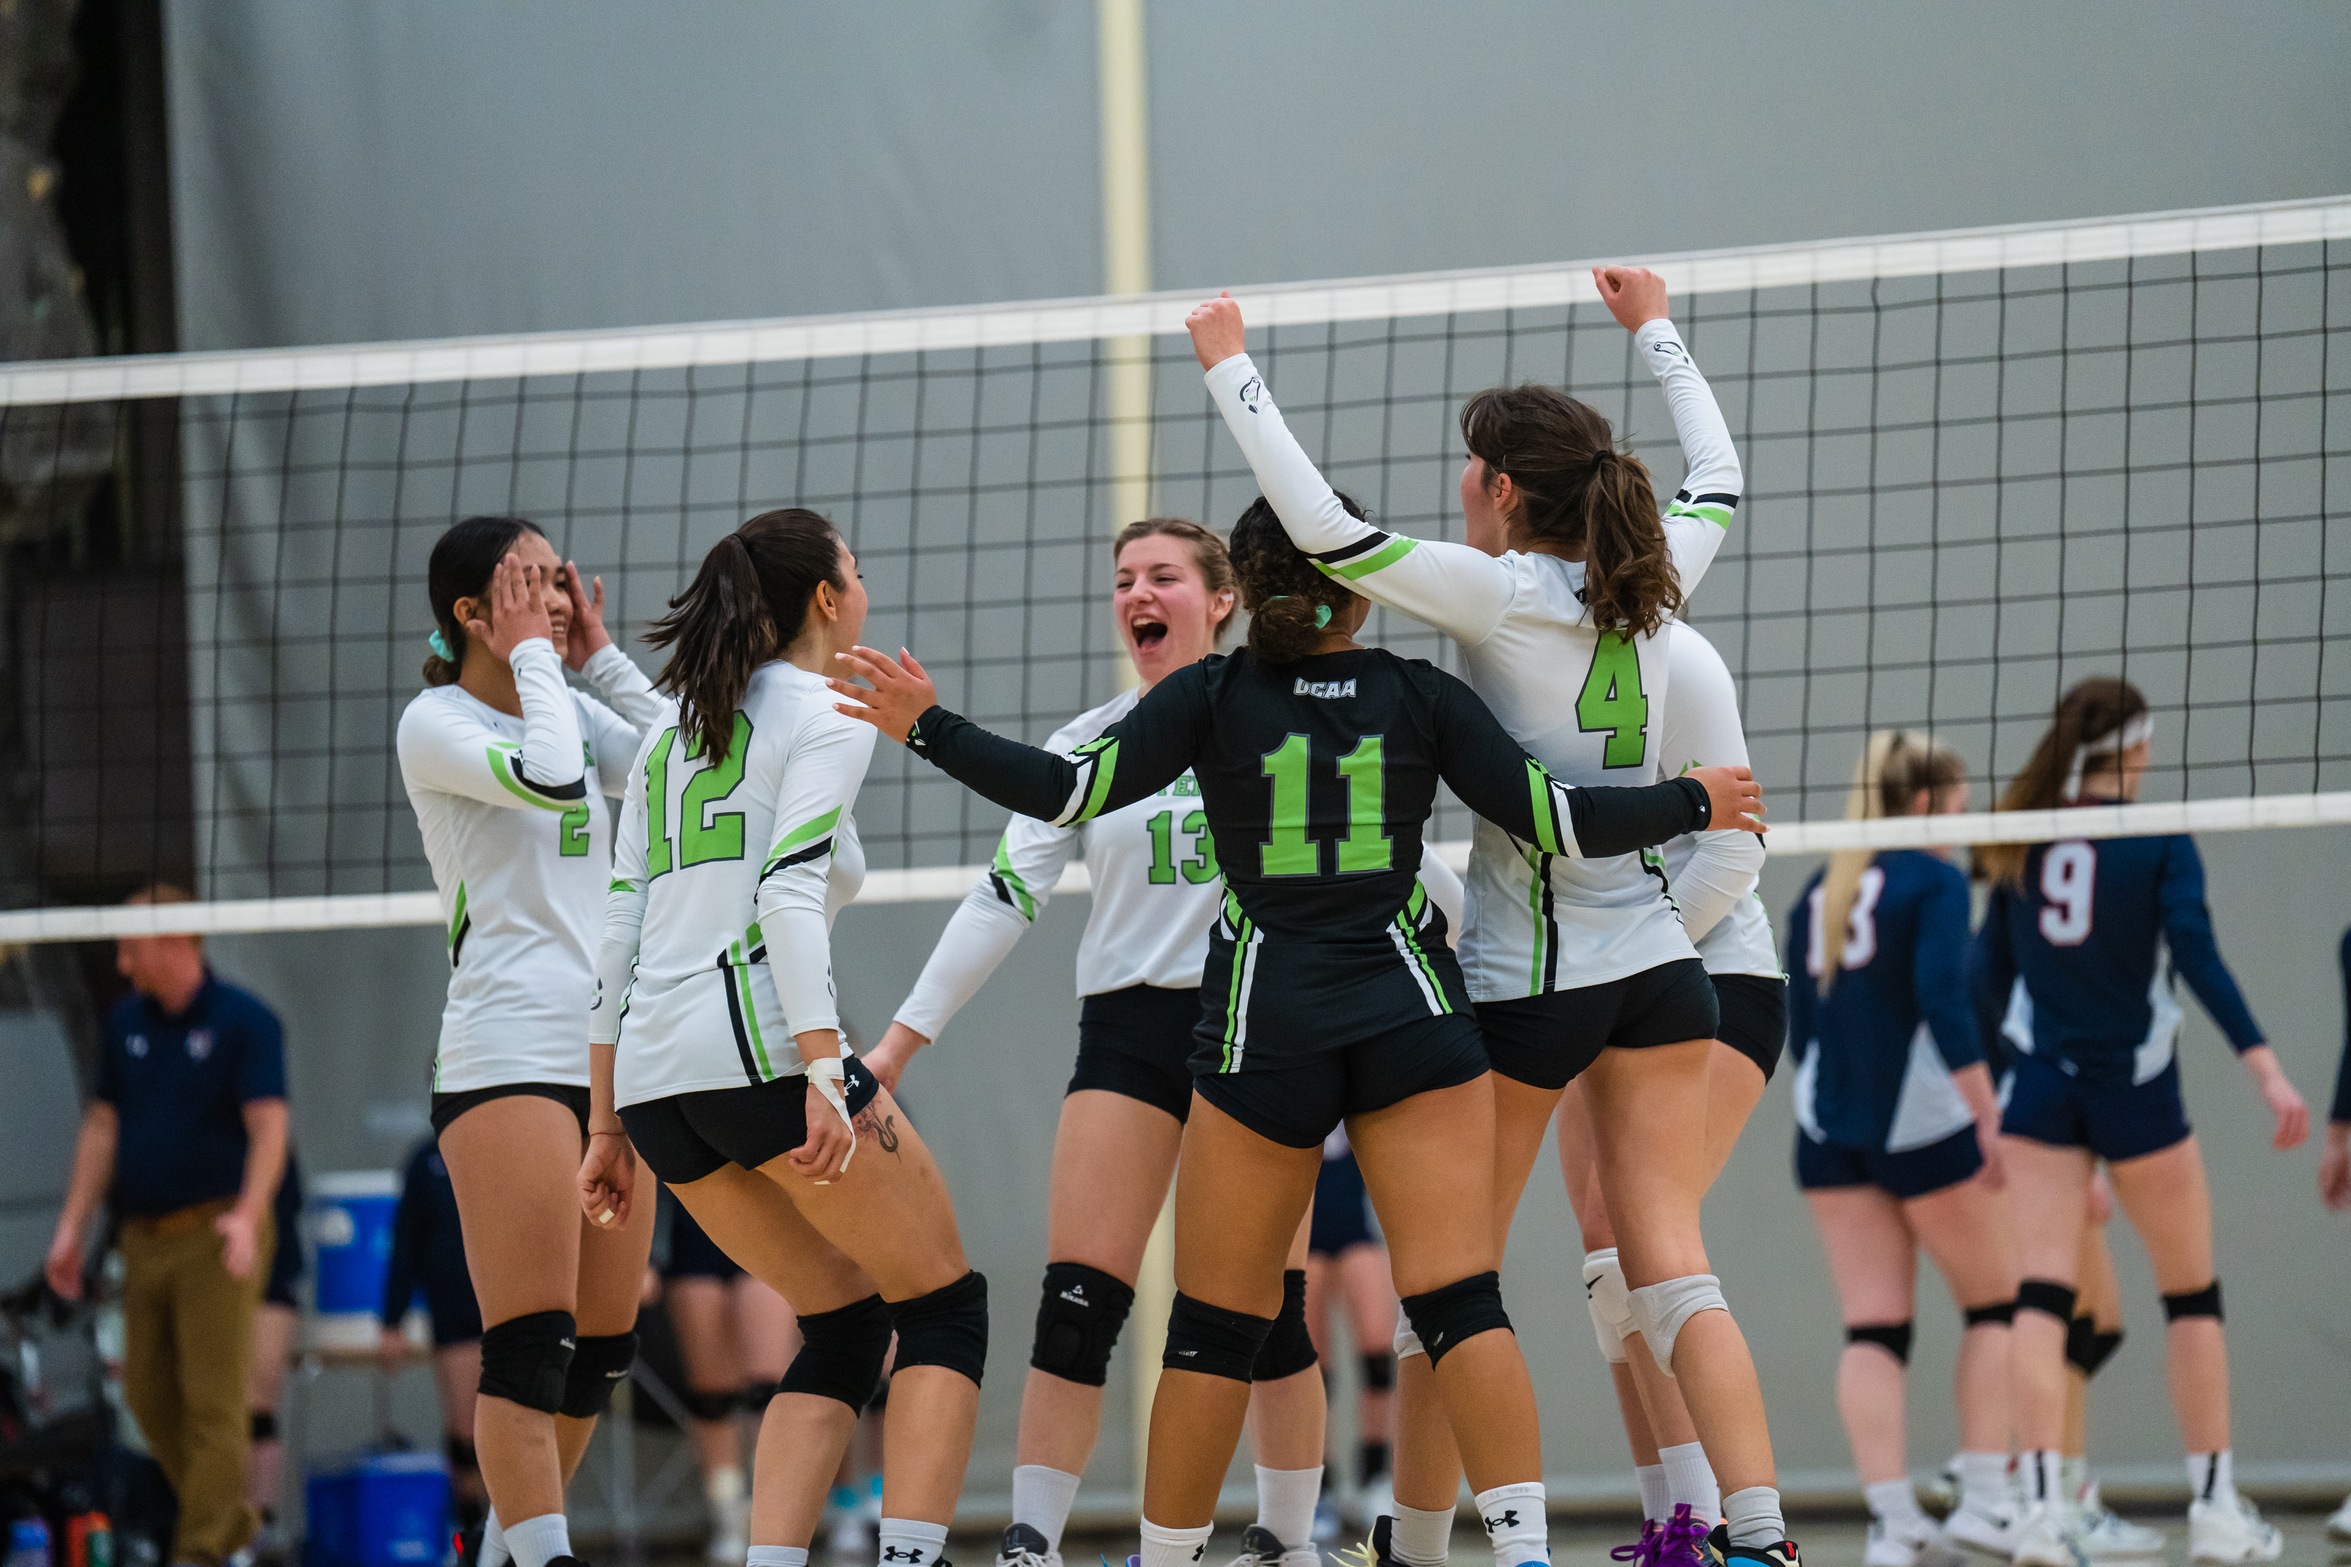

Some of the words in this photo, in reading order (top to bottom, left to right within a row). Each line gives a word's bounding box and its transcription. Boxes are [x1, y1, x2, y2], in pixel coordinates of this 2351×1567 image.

[1575, 629, 1649, 770] 4
[560, 800, 590, 857] 2
[644, 708, 755, 884] 12
[1146, 809, 1221, 885] 13
[1259, 731, 1394, 878] 11
[2038, 838, 2097, 948] 9
